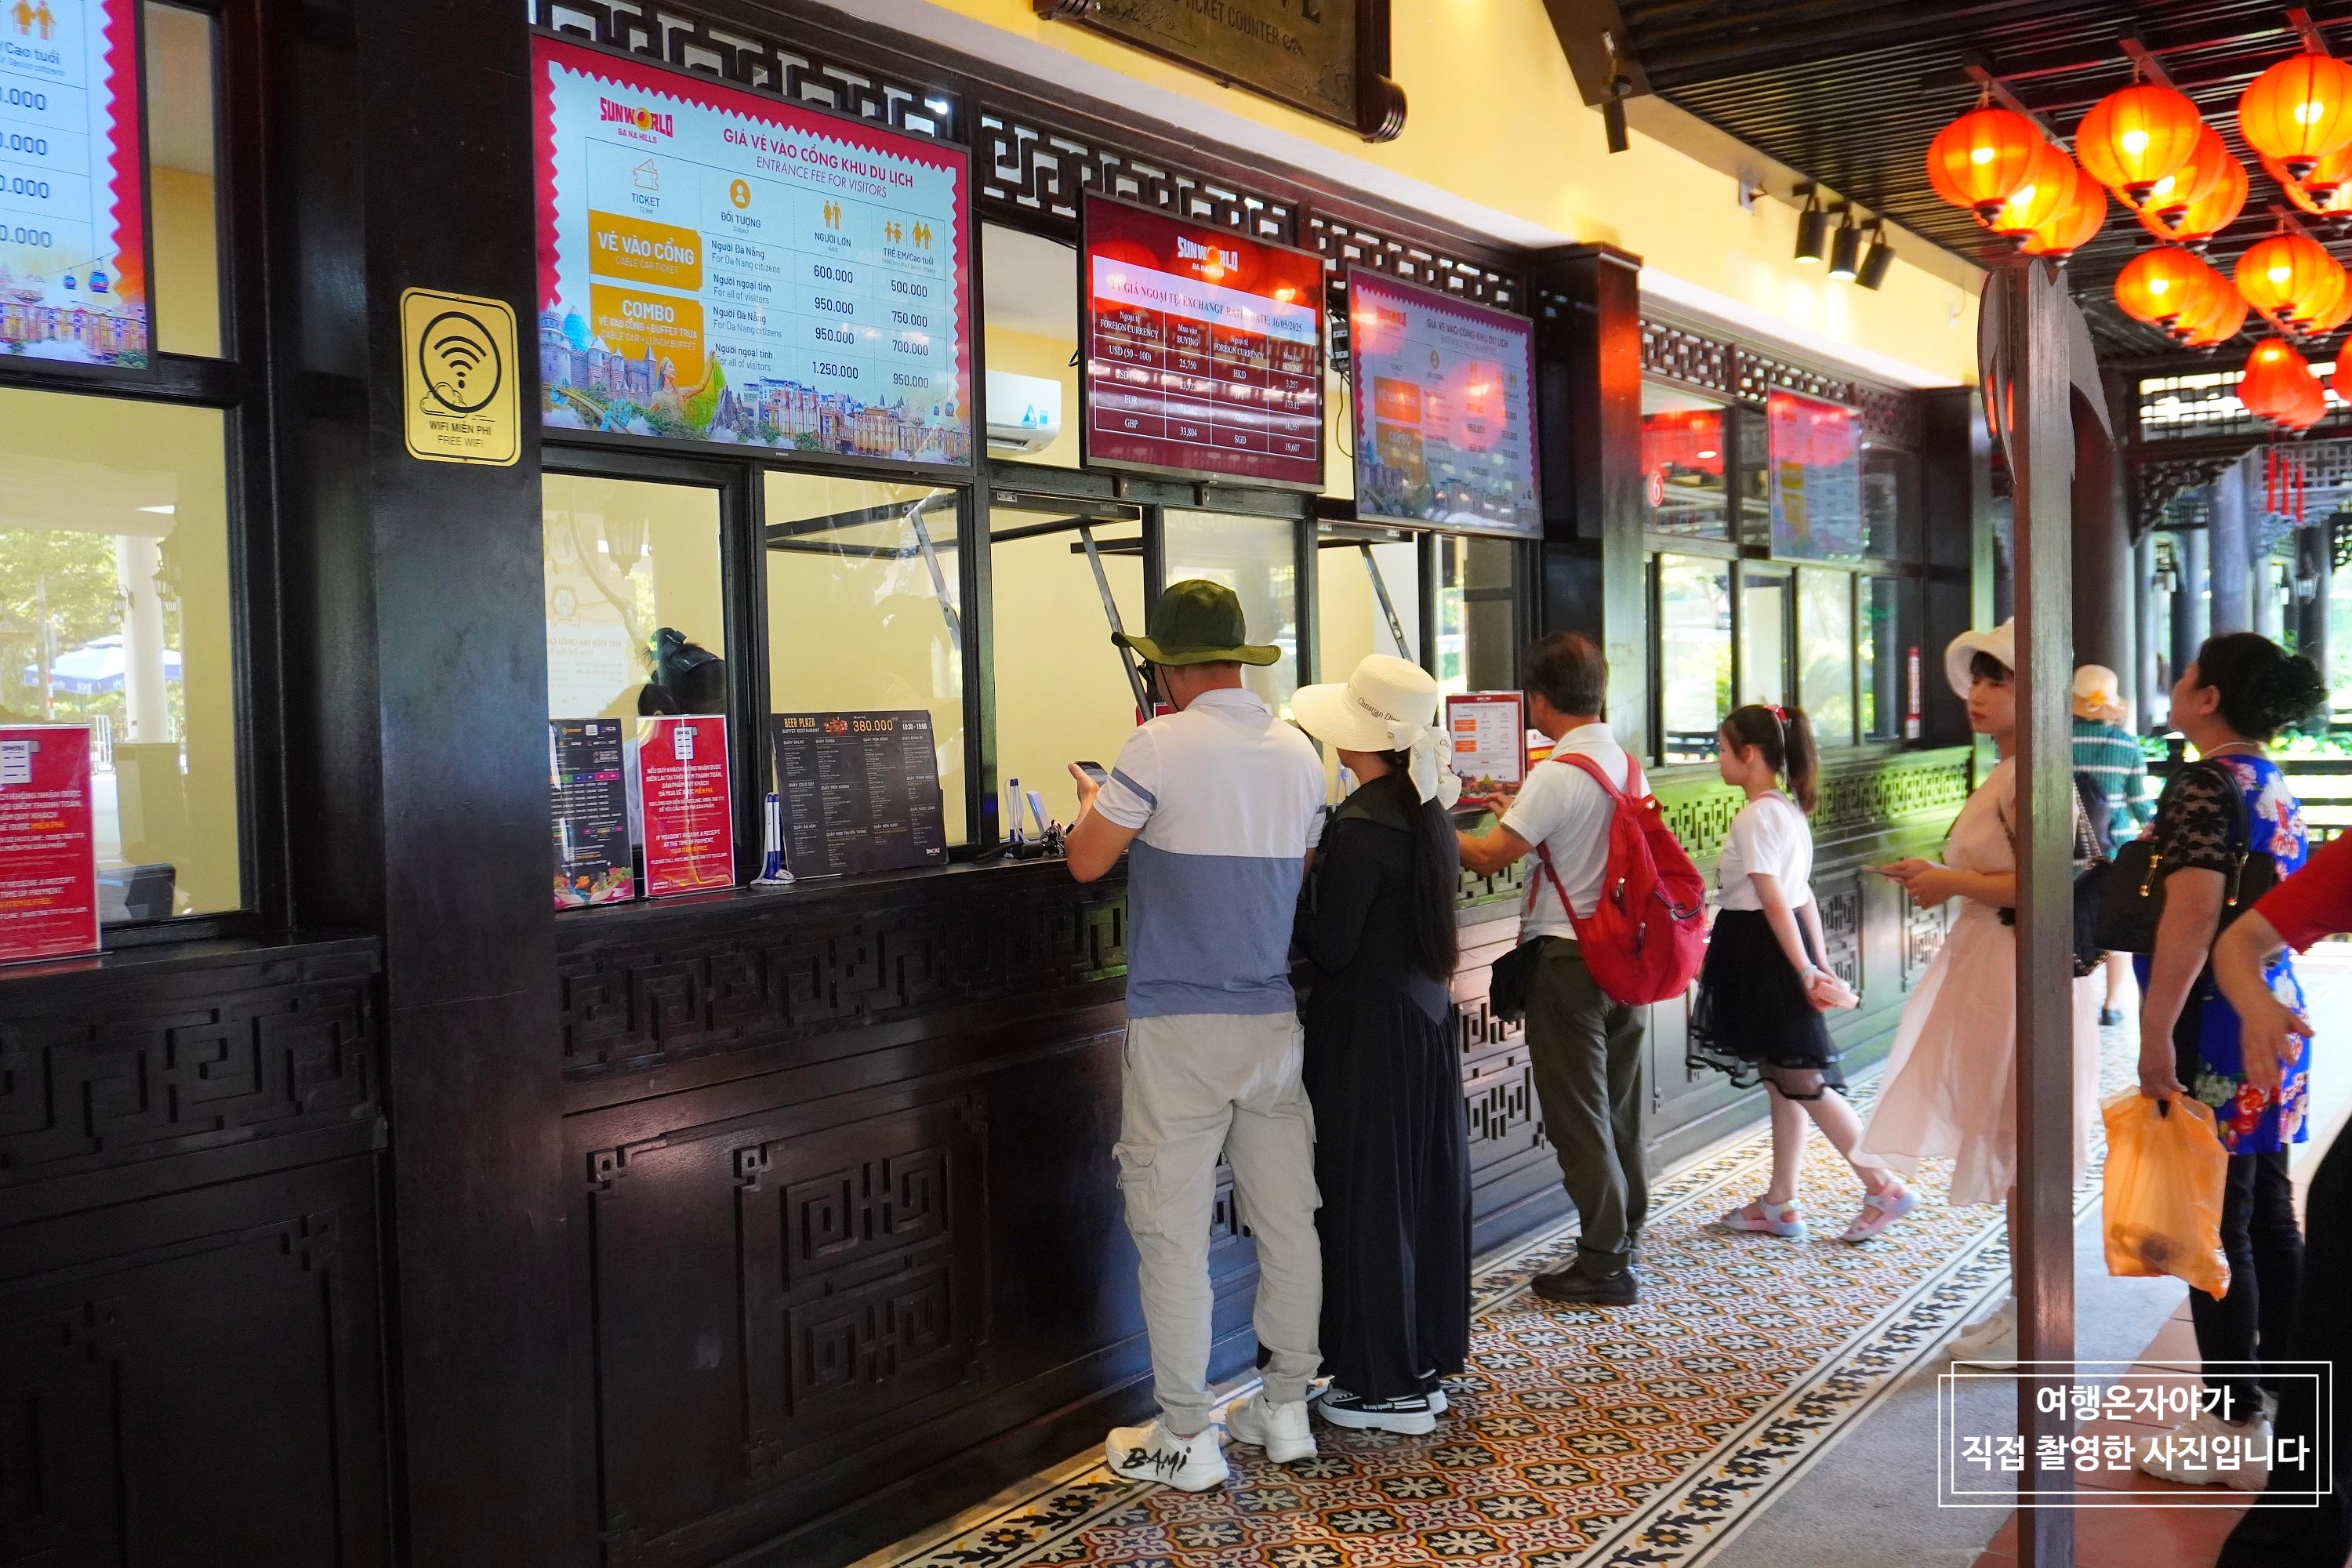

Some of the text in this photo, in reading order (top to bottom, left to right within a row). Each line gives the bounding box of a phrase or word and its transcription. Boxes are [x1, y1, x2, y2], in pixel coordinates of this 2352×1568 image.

[1229, 7, 1279, 47] COUNTER
[619, 128, 657, 143] BA NA HILLS
[724, 129, 748, 147] GIÁ
[771, 140, 797, 158] VÀO
[801, 144, 838, 169] CỔNG
[841, 158, 866, 175] KHU
[870, 165, 886, 181] DU
[890, 171, 913, 188] LỊCH
[757, 157, 887, 198] ENTRANCE FEE FOR VISITORS
[632, 193, 660, 207] TICKET
[720, 211, 734, 223] ĐỐI
[622, 234, 651, 257] VÀO
[654, 237, 695, 266] CỔNG
[712, 240, 733, 252] Người
[735, 245, 744, 254] Đà
[616, 256, 679, 274] CABLE CAR TICKET
[712, 252, 781, 274] For Da Nang citizens
[714, 274, 735, 286] Người
[737, 279, 757, 291] ngoại
[815, 265, 853, 283] 600.000
[713, 287, 725, 296] For
[736, 290, 744, 299] of
[745, 293, 770, 305] visitors
[891, 280, 927, 297] 500.000
[622, 299, 674, 323] COMBO
[713, 307, 734, 319] Người
[737, 310, 746, 320] Đà
[815, 297, 854, 314] 950.000
[1142, 286, 1167, 303] NGOẠI
[1272, 317, 1302, 332] 16/05/2025
[892, 310, 927, 327] 750.000
[651, 325, 678, 336] BUFFET
[713, 319, 782, 338] For Da Nang citizens
[815, 327, 854, 344] 950.000
[1101, 319, 1159, 339] FOREIGN CURRENCY
[626, 332, 641, 343] CAR
[646, 336, 670, 346] LUNCH
[670, 339, 697, 351] BUFFET
[893, 339, 928, 356] 700.000
[1177, 335, 1199, 347] BUYING
[715, 343, 736, 355] Người
[738, 347, 758, 358] ngoại
[1109, 344, 1151, 363] USD (50 100)
[1214, 343, 1265, 360] FOREIGN CURRENCY
[728, 358, 737, 367] all
[738, 358, 746, 368] of
[746, 361, 771, 372] visitors
[812, 361, 858, 379] 1.250.000
[1179, 358, 1196, 369] 25,750
[893, 373, 929, 388] 950.000
[1233, 369, 1247, 379] HKD
[1286, 379, 1298, 389] 3,257
[1124, 394, 1138, 405] EUR
[429, 420, 448, 430] WIFI
[1125, 419, 1138, 428] GBP
[1181, 426, 1197, 437] 33,804
[437, 435, 483, 448] FREE WIFI
[1235, 435, 1247, 444] SGD
[1652, 477, 1661, 501] 6
[1357, 697, 1384, 718] Christian
[784, 717, 815, 728] BEER PLAZA
[852, 720, 893, 731] 380.000
